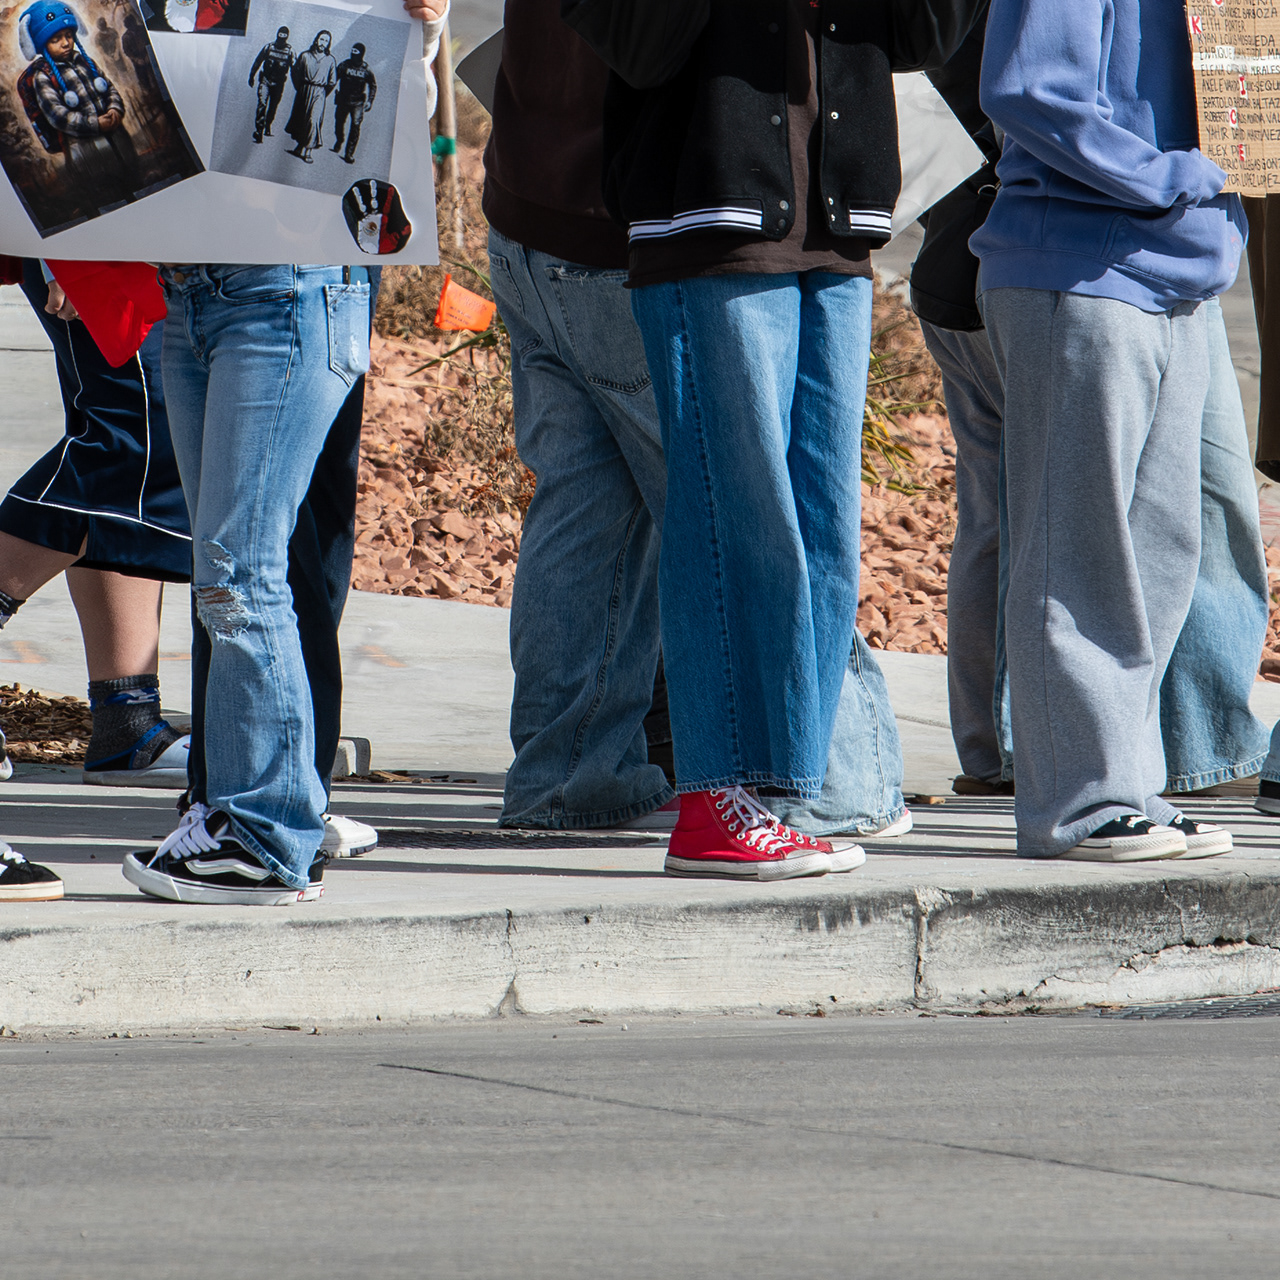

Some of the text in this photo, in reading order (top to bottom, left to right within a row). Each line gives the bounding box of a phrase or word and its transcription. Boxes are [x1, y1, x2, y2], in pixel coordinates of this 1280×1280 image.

[1191, 16, 1247, 34] KEITH PORTER
[345, 67, 367, 79] POLICE
[1207, 144, 1228, 158] ALEX
